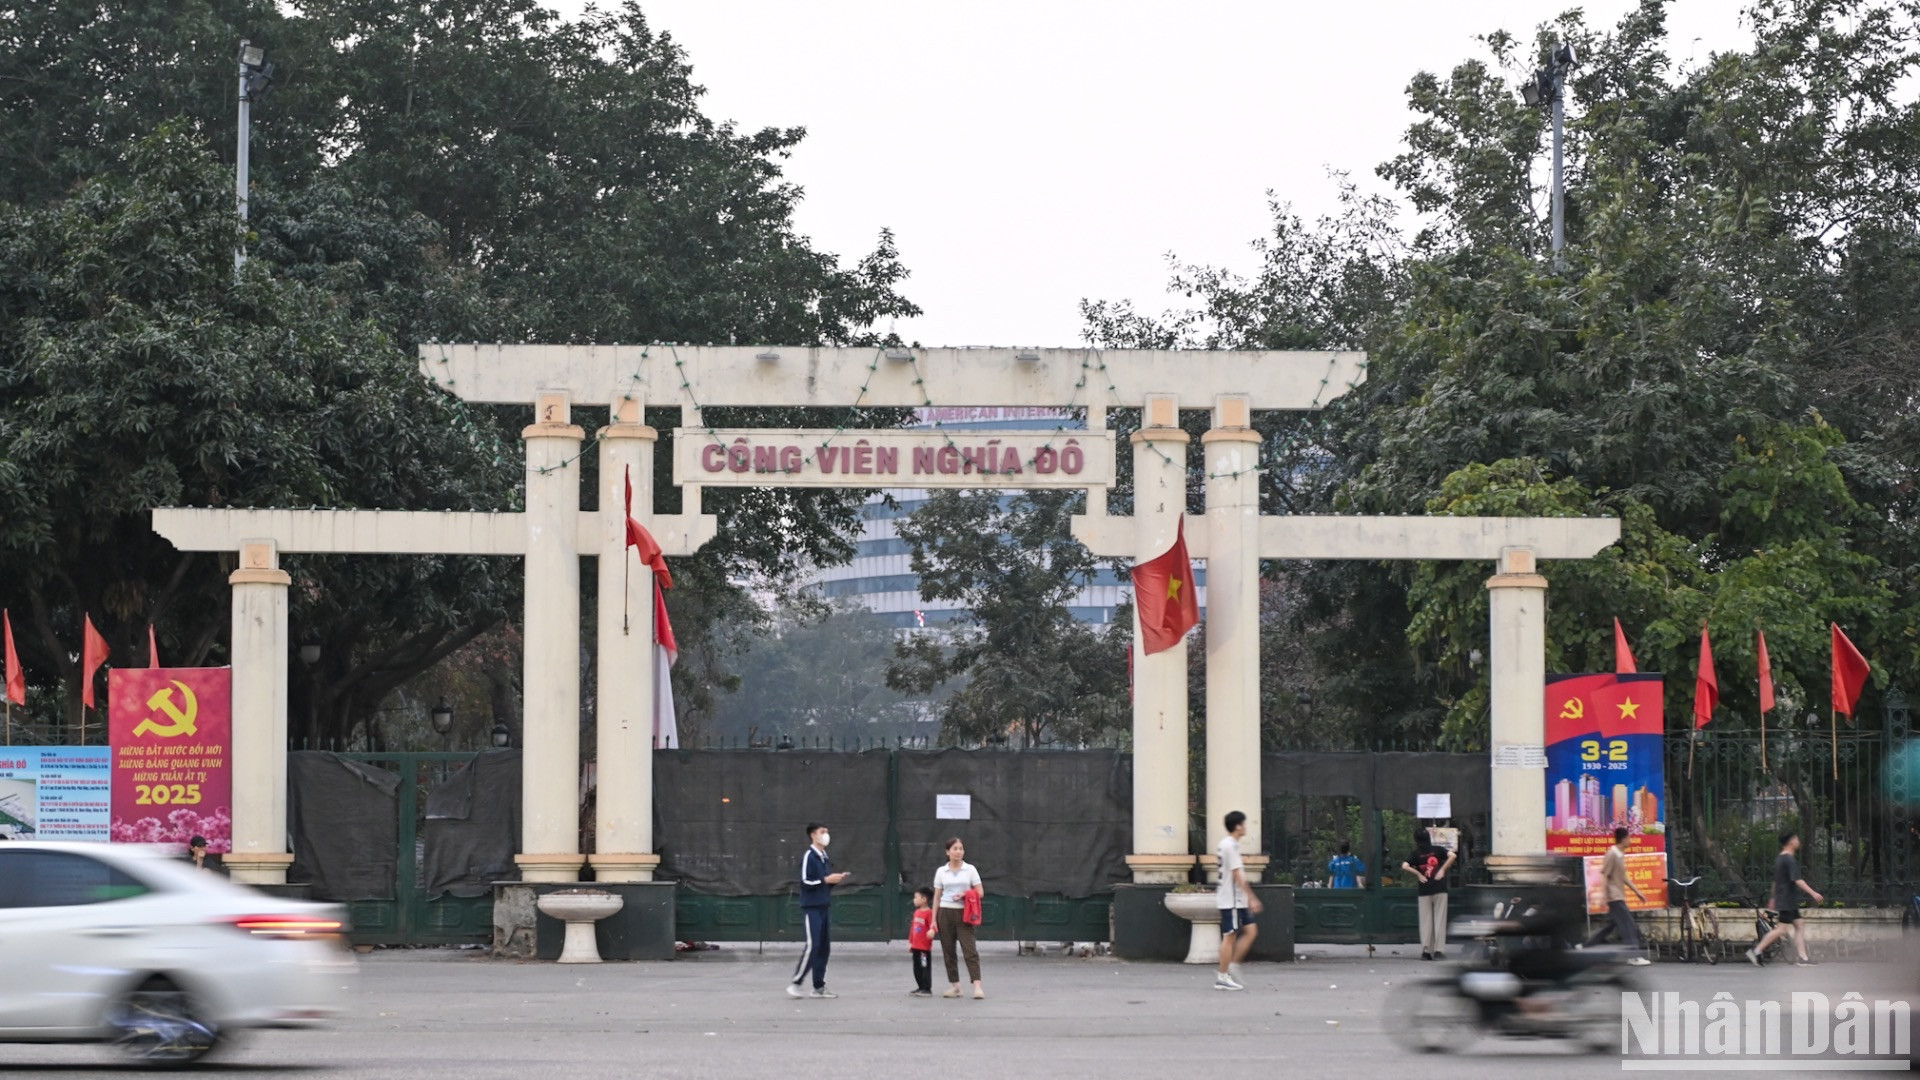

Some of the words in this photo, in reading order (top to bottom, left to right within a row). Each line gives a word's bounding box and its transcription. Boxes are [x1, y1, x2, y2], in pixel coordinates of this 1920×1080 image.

[926, 406, 998, 421] AMERICAN
[701, 437, 801, 474] CÔNG
[815, 438, 898, 474] VIÊN
[912, 438, 1023, 475] NGHĨA
[1035, 438, 1084, 475] ĐÔ
[1581, 740, 1628, 761] 3-2
[171, 758, 200, 770] QUANG
[201, 758, 223, 769] VINH
[1582, 762, 1601, 770] 1930
[1608, 762, 1628, 770] 2025
[135, 784, 202, 805] 2025
